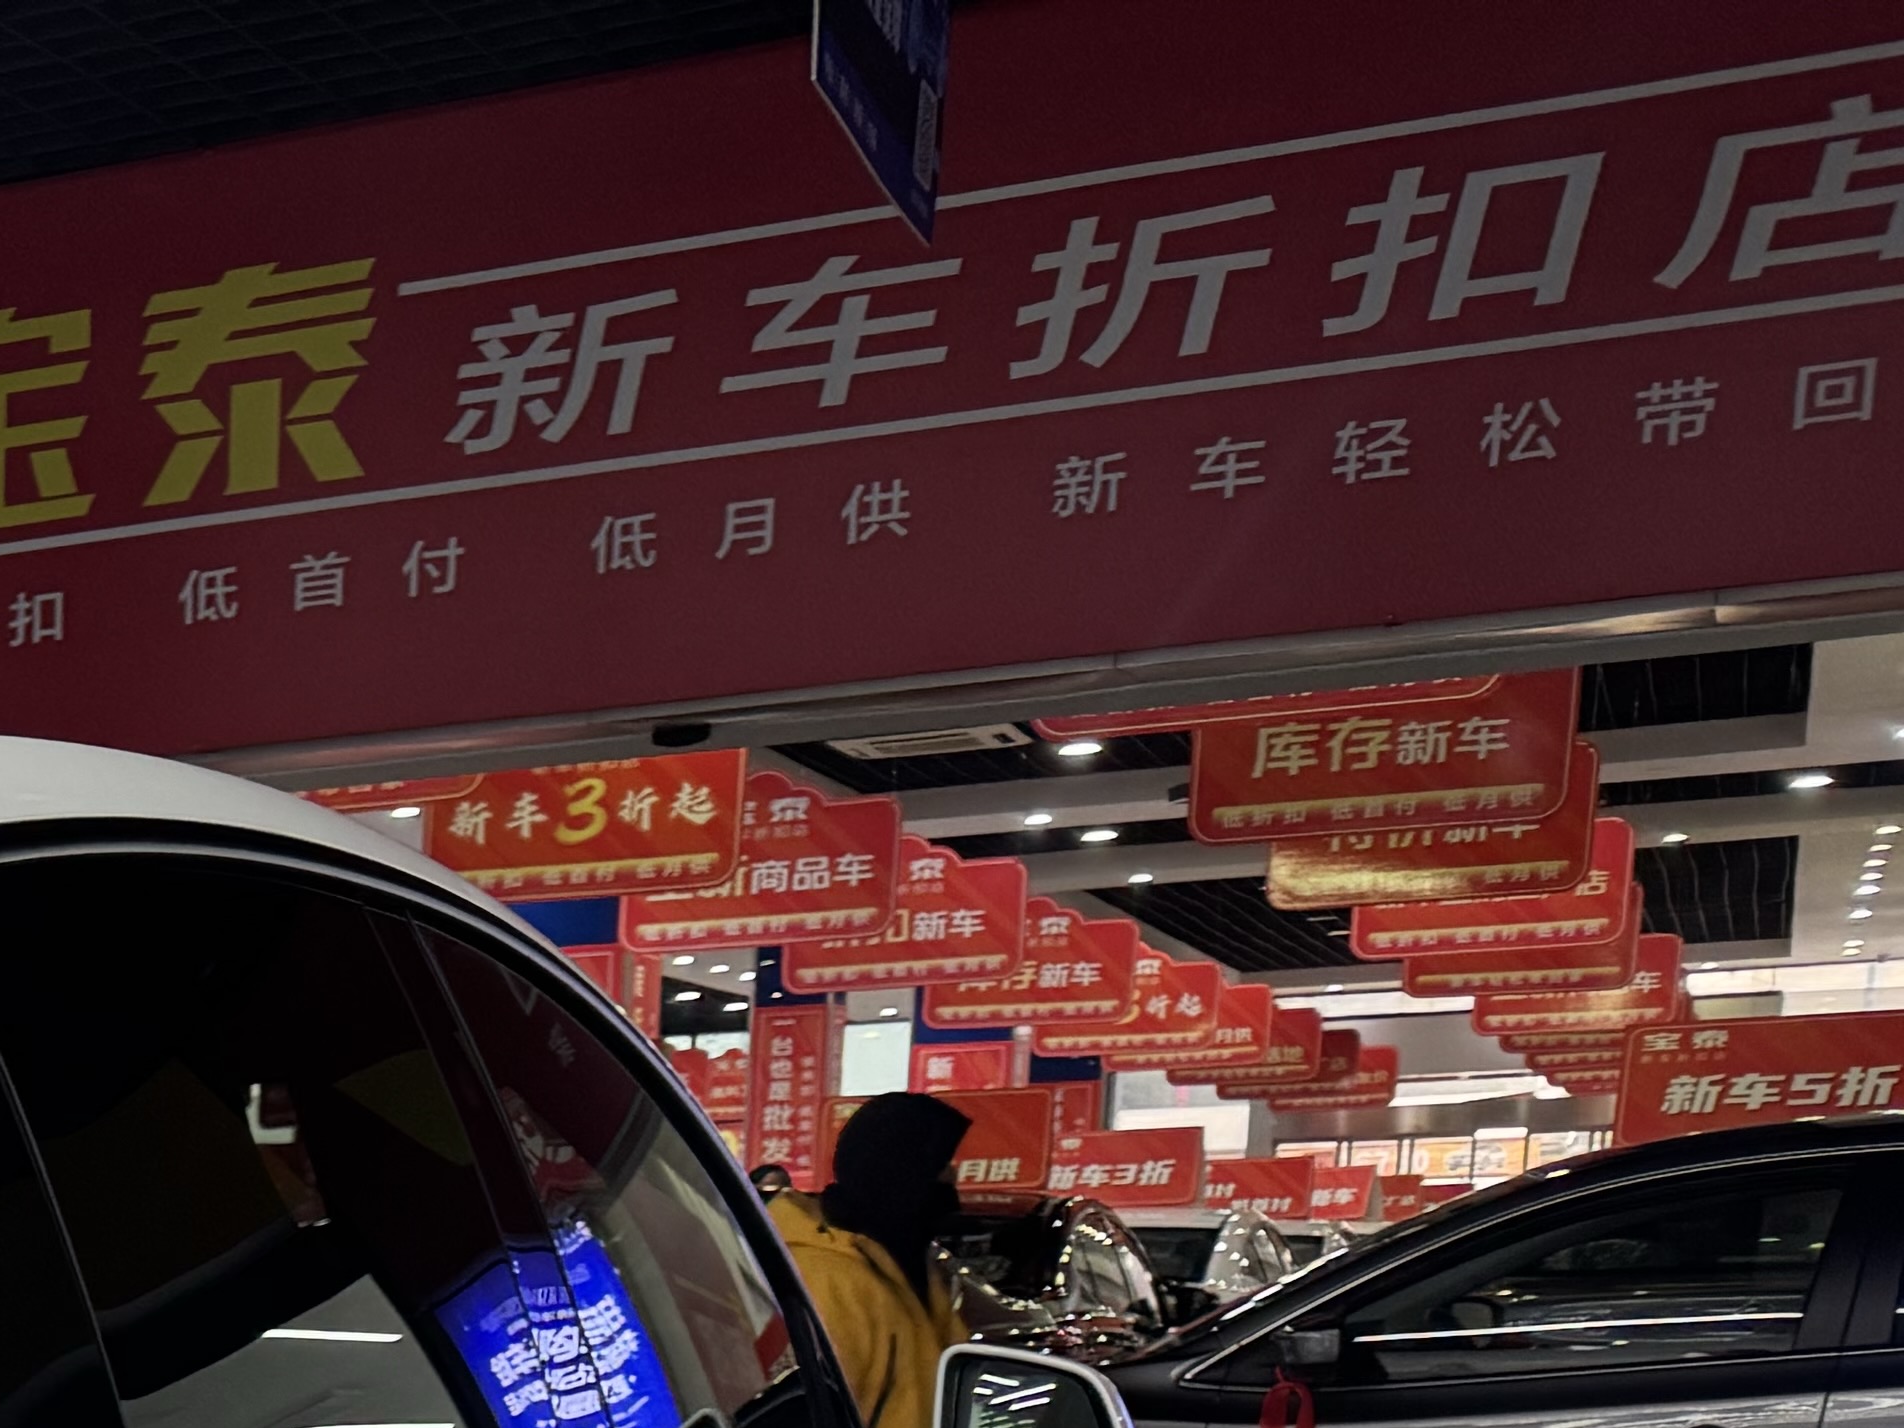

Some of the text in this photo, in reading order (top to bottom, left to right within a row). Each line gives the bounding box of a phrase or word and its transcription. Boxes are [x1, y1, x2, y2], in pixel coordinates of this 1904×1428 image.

[445, 94, 1904, 455] 新车折扣店
[177, 537, 465, 624] 低首付
[590, 480, 911, 575] 低月供
[1051, 357, 1880, 520] 新车轻松带回
[1252, 716, 1511, 779] 库存新车
[448, 777, 717, 846] 新车3折起
[958, 960, 1104, 992] 存新车
[1641, 1029, 1729, 1051] 宝泰
[1660, 1064, 1902, 1116] 新车5折
[1048, 1158, 1177, 1191] 新车3折
